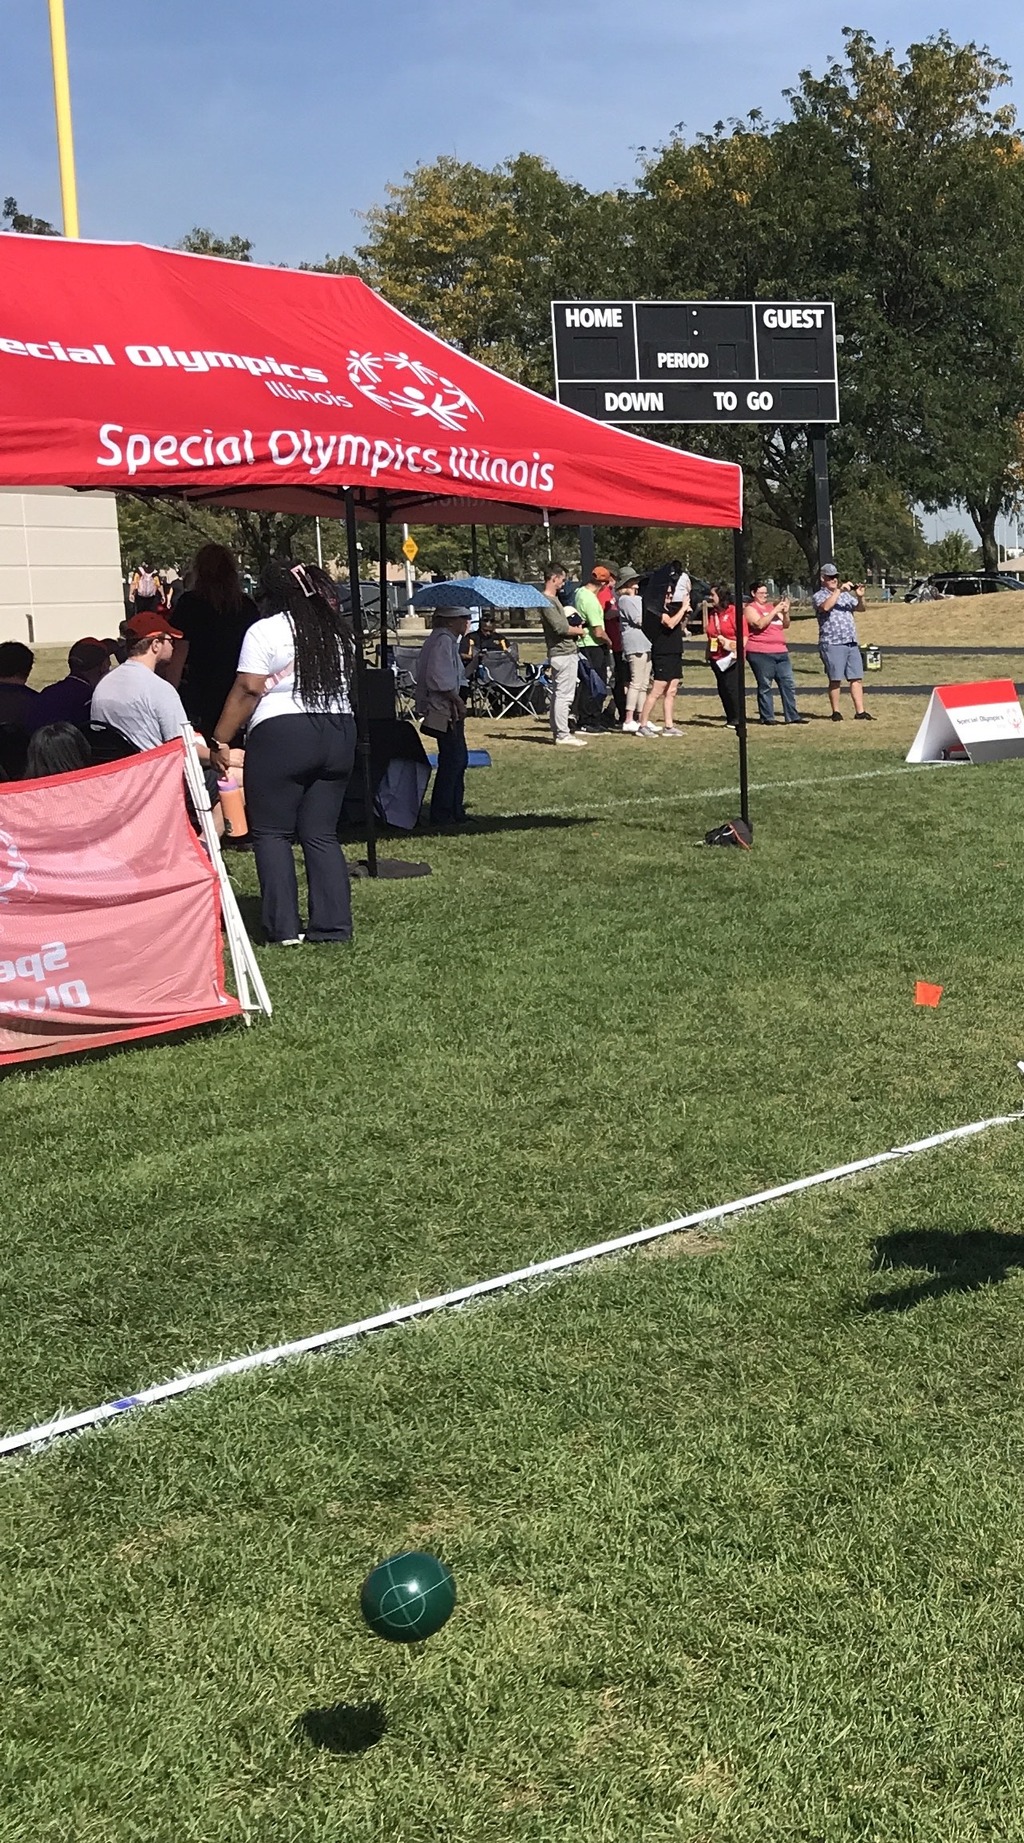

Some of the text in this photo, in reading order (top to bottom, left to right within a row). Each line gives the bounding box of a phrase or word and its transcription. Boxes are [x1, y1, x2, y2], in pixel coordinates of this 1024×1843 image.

[564, 308, 624, 328] HOME
[762, 309, 825, 329] GUEST
[0, 337, 329, 384] ecial Olympics
[657, 352, 709, 369] PERIOD
[264, 380, 354, 409] Illinois
[604, 392, 665, 412] DOWN
[713, 391, 774, 411] TO GO
[96, 423, 555, 492] Special Olympics Illinois
